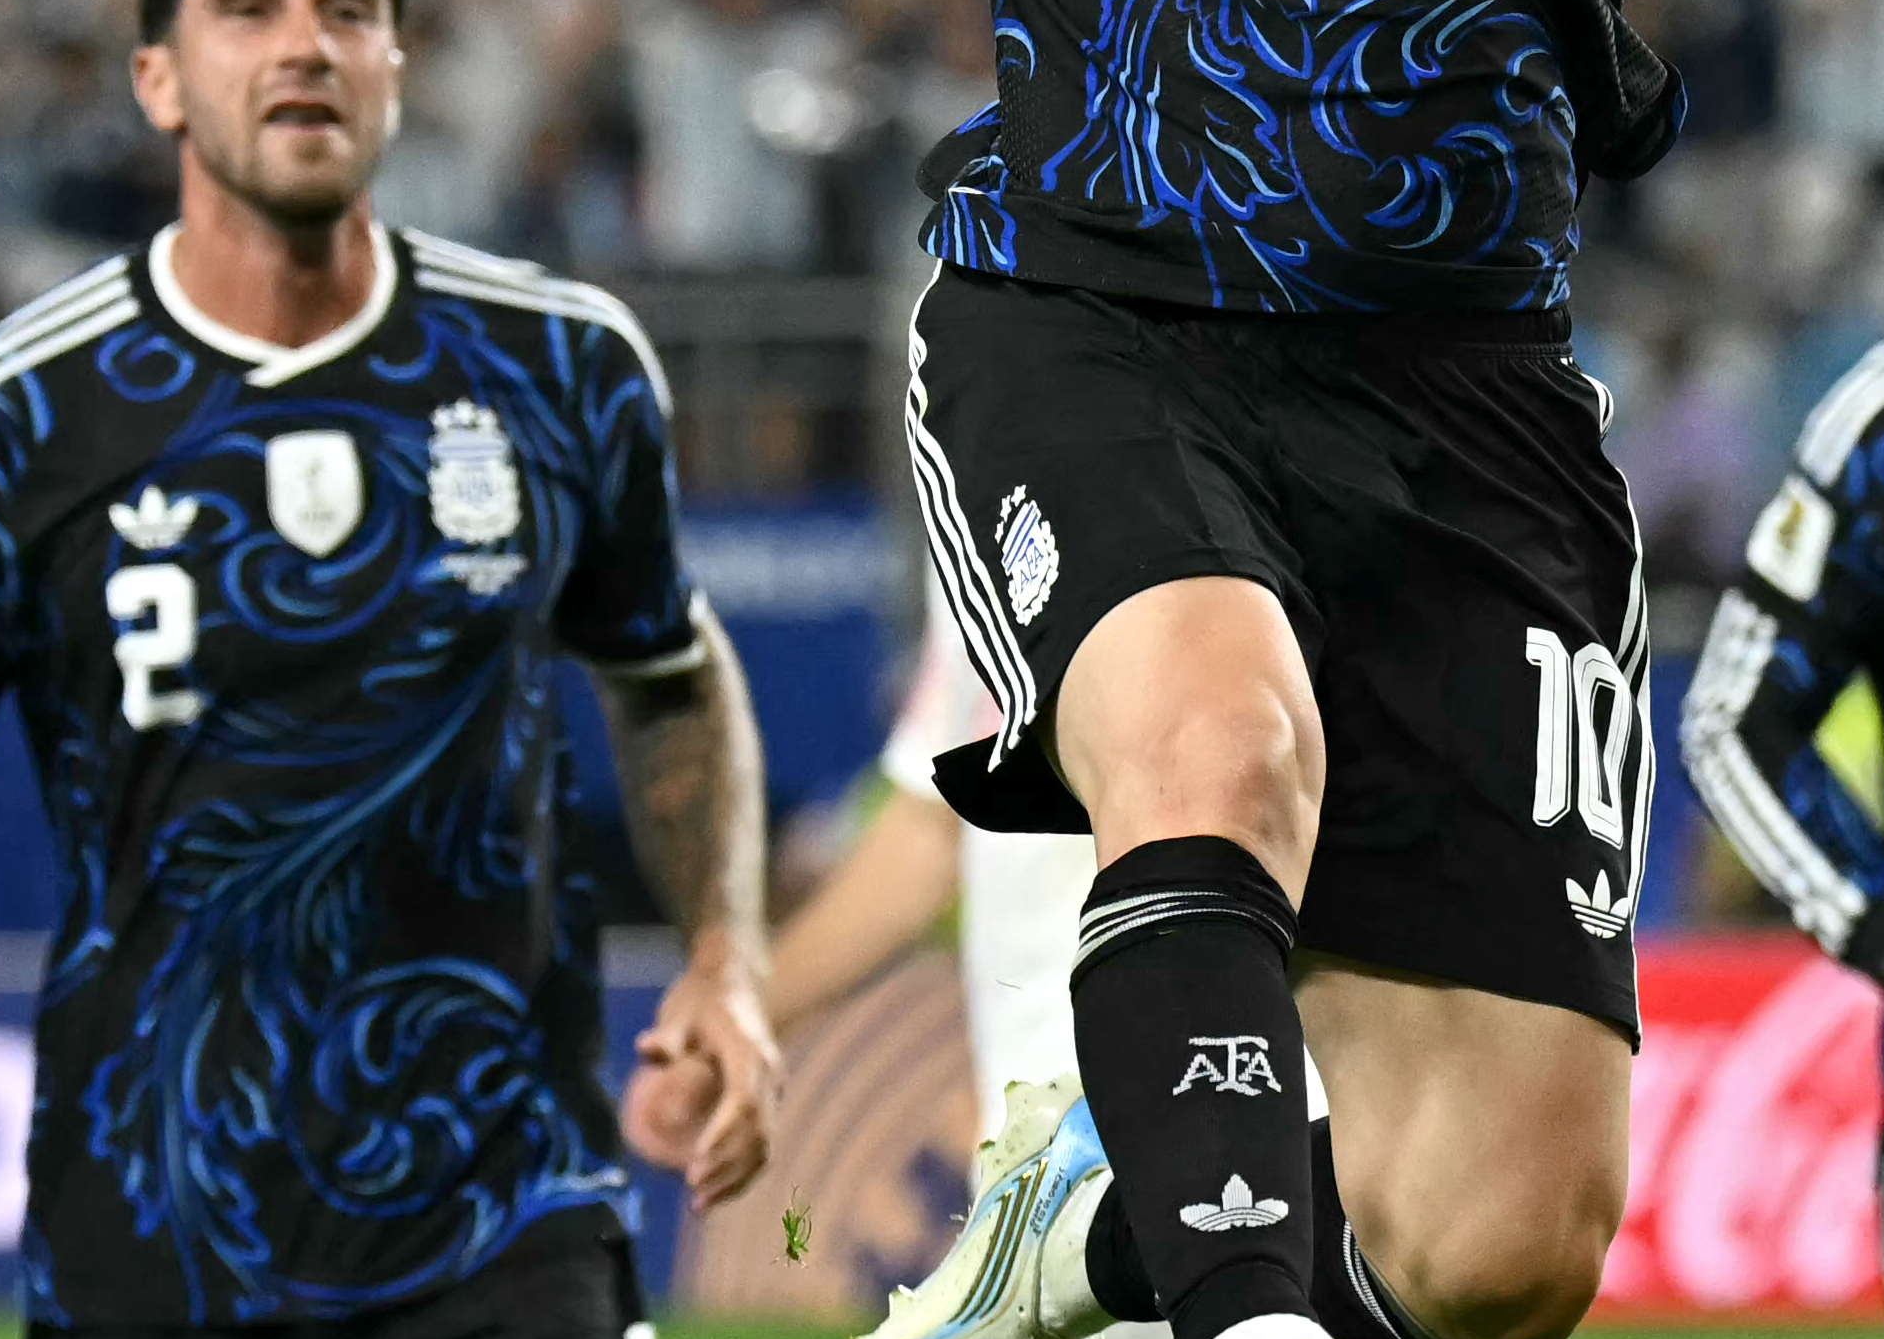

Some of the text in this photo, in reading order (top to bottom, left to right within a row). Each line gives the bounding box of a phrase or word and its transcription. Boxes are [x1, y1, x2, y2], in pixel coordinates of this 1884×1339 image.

[107, 563, 207, 731] 2
[1527, 626, 1633, 850] 10
[1173, 1036, 1282, 1096] AFA
